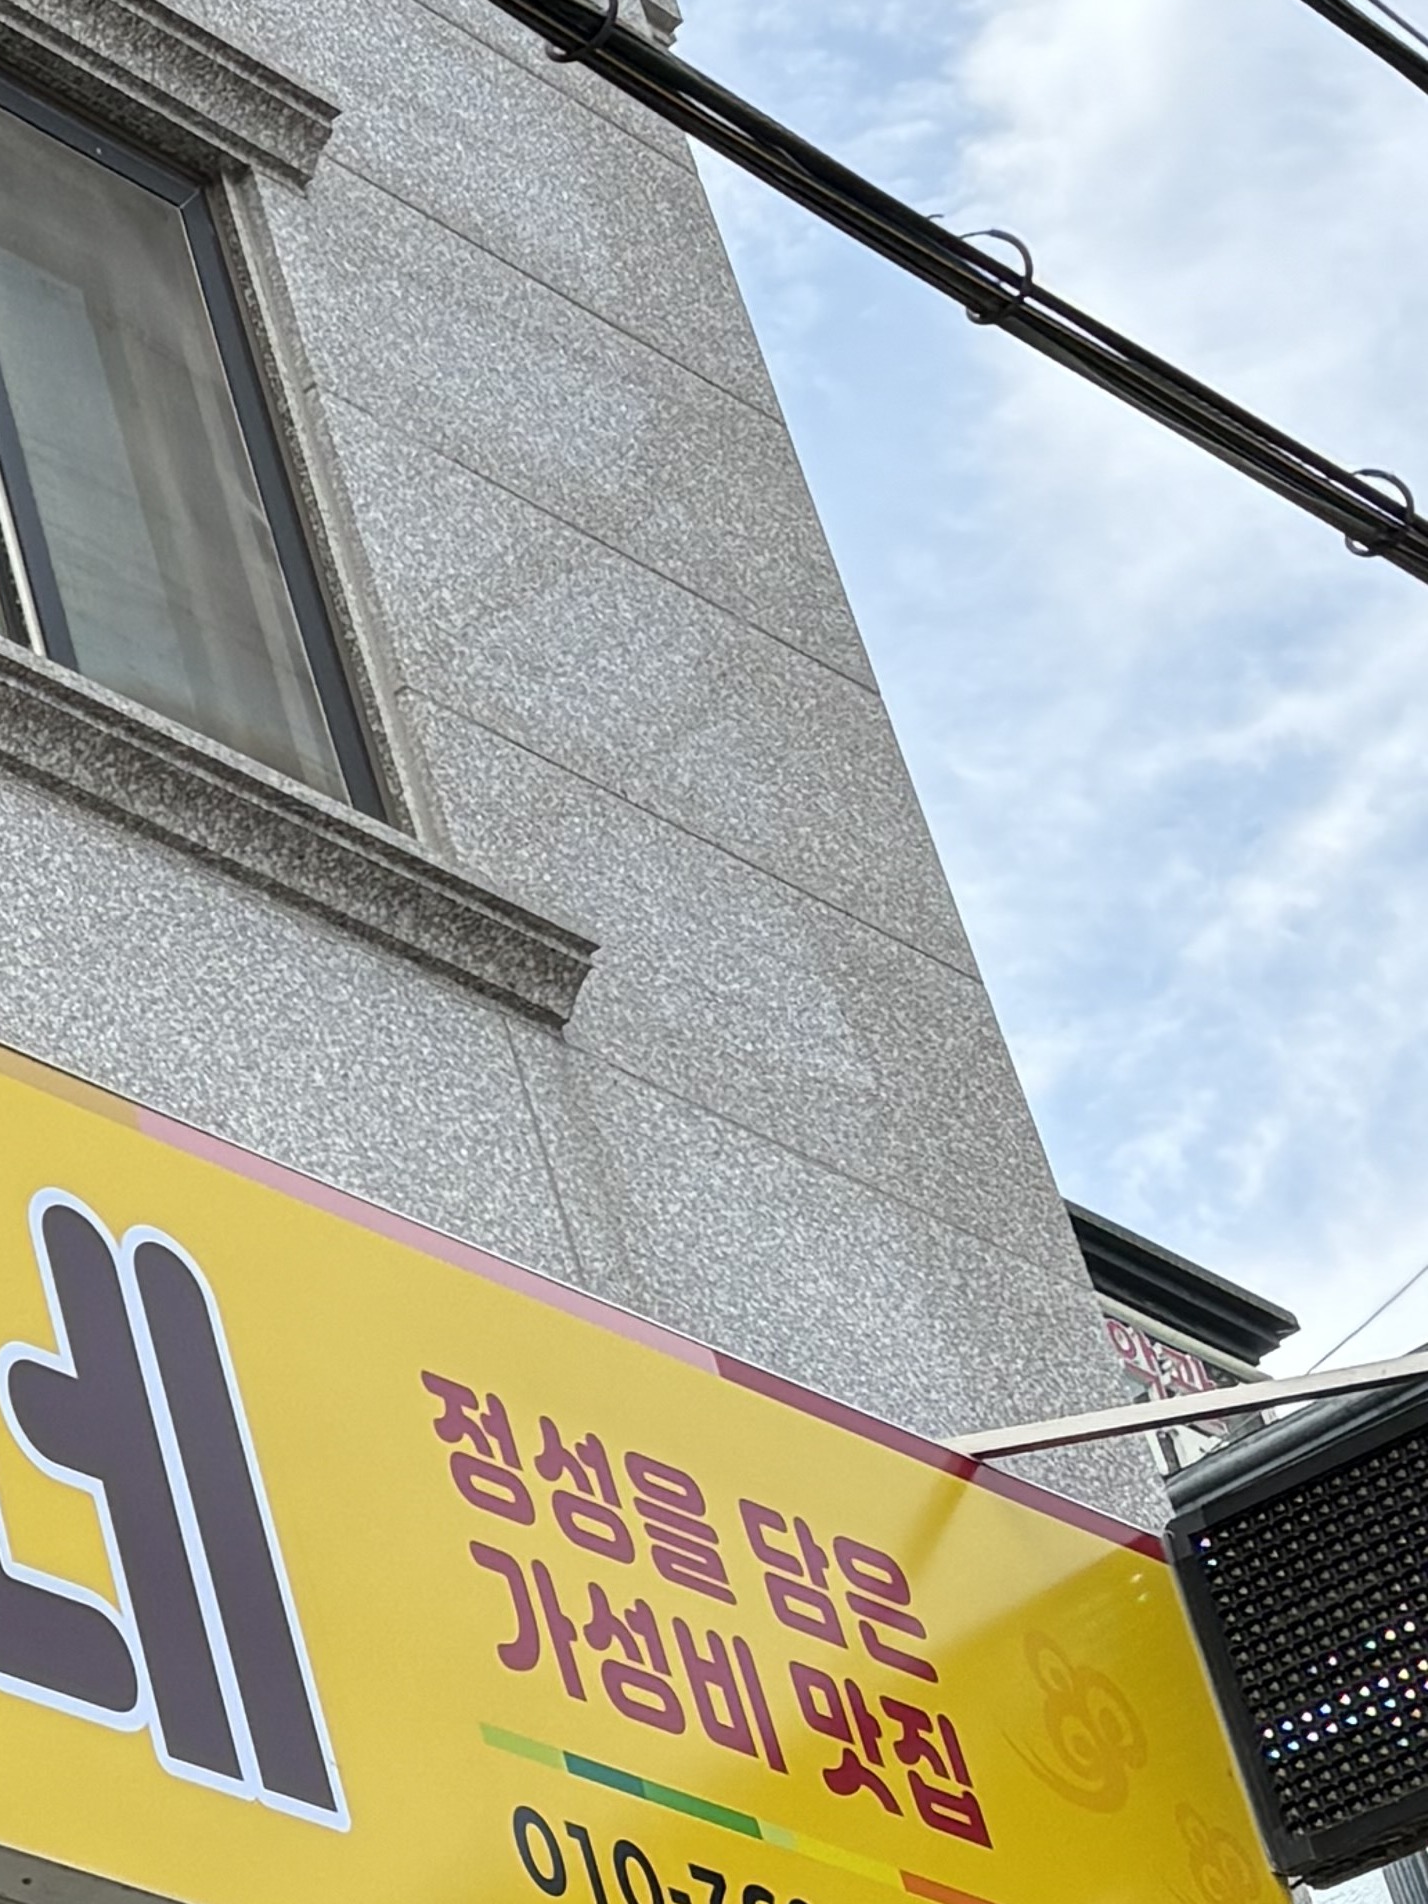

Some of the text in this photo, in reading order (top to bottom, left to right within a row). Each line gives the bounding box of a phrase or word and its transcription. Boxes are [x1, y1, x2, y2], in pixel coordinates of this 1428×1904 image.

[420, 1369, 939, 1684] 정성을 담은
[468, 1540, 994, 1850] 가성비 맛집
